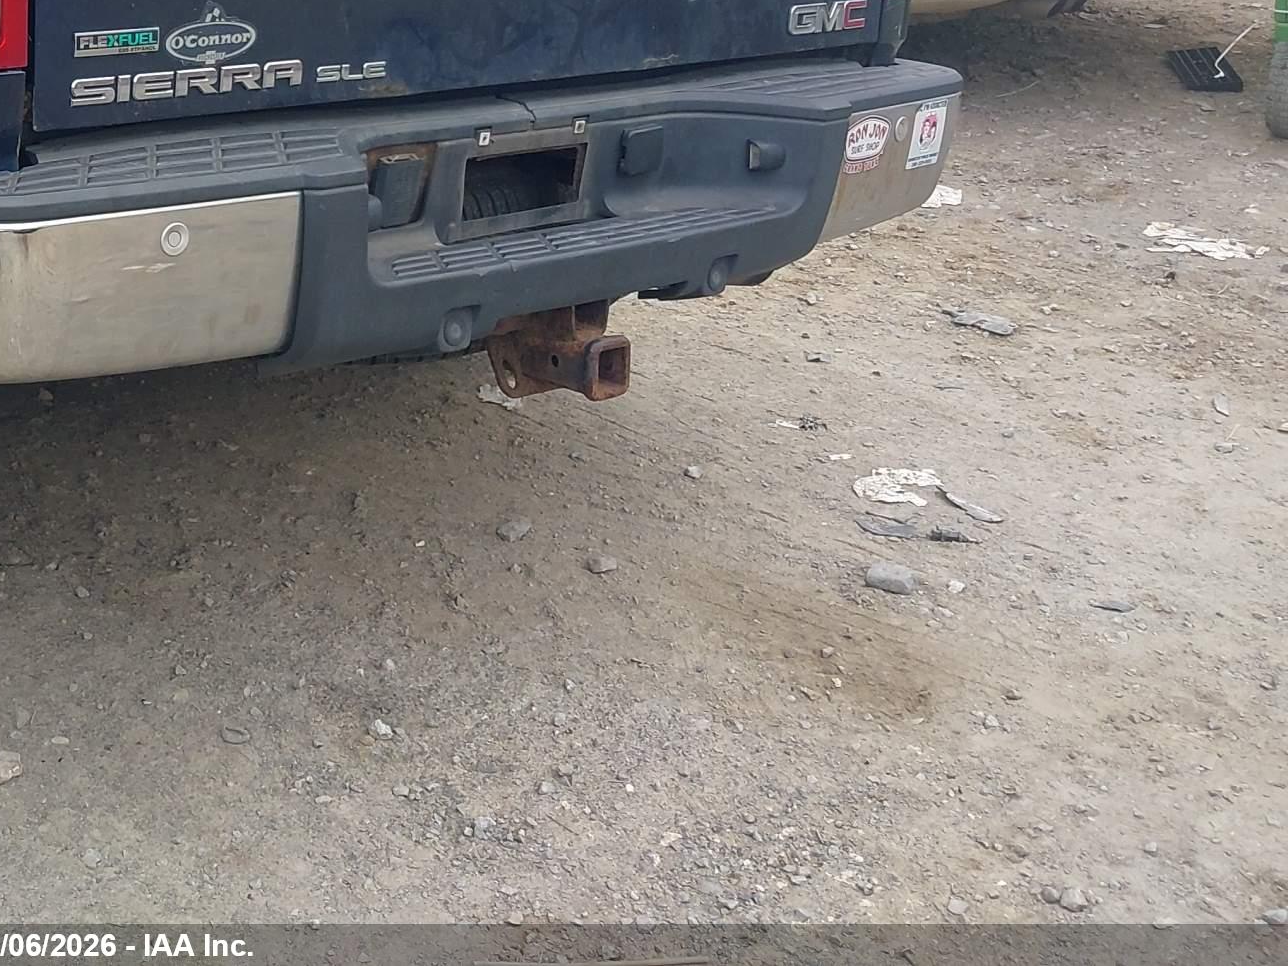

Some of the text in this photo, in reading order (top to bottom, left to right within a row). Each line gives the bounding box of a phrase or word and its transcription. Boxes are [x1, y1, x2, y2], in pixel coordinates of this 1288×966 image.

[171, 31, 250, 50] O'Connor
[70, 59, 387, 106] SIERRA SLE
[848, 123, 888, 147] RON JON
[851, 141, 880, 154] SURF SHOP
